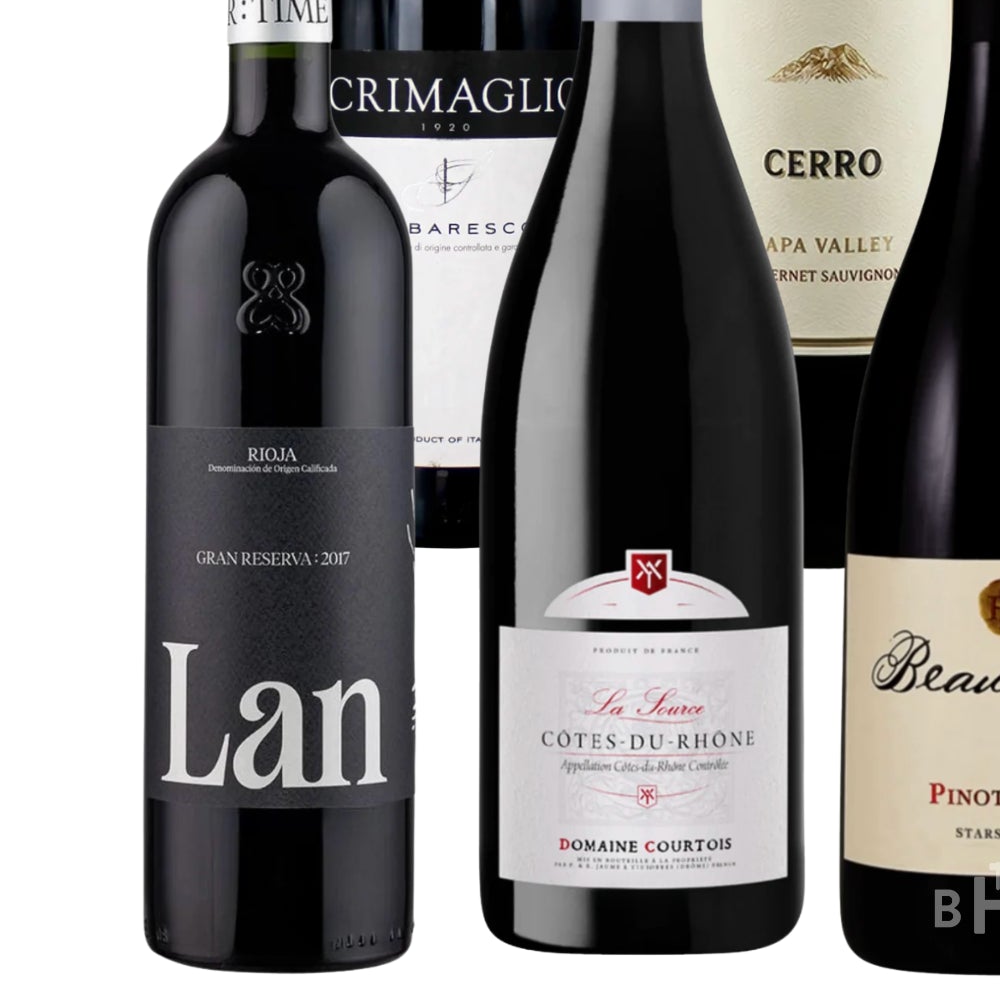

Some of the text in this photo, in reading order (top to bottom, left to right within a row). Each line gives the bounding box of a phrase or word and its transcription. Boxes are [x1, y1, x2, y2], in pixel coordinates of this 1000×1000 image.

[422, 123, 470, 132] 1920
[764, 148, 883, 178] CERRO
[815, 236, 894, 253] VALLEY
[248, 447, 297, 462] RIOJA
[208, 464, 261, 473] Denominación
[263, 464, 273, 473] de
[301, 464, 338, 473] Calificada
[196, 551, 238, 566] GRAN
[241, 552, 312, 566] RESERVA
[320, 551, 351, 566] 2017
[584, 687, 706, 716] La Source
[161, 641, 388, 790] Lan
[561, 760, 611, 774] Appellation
[559, 838, 732, 853] DOMAINE COURTOIS
